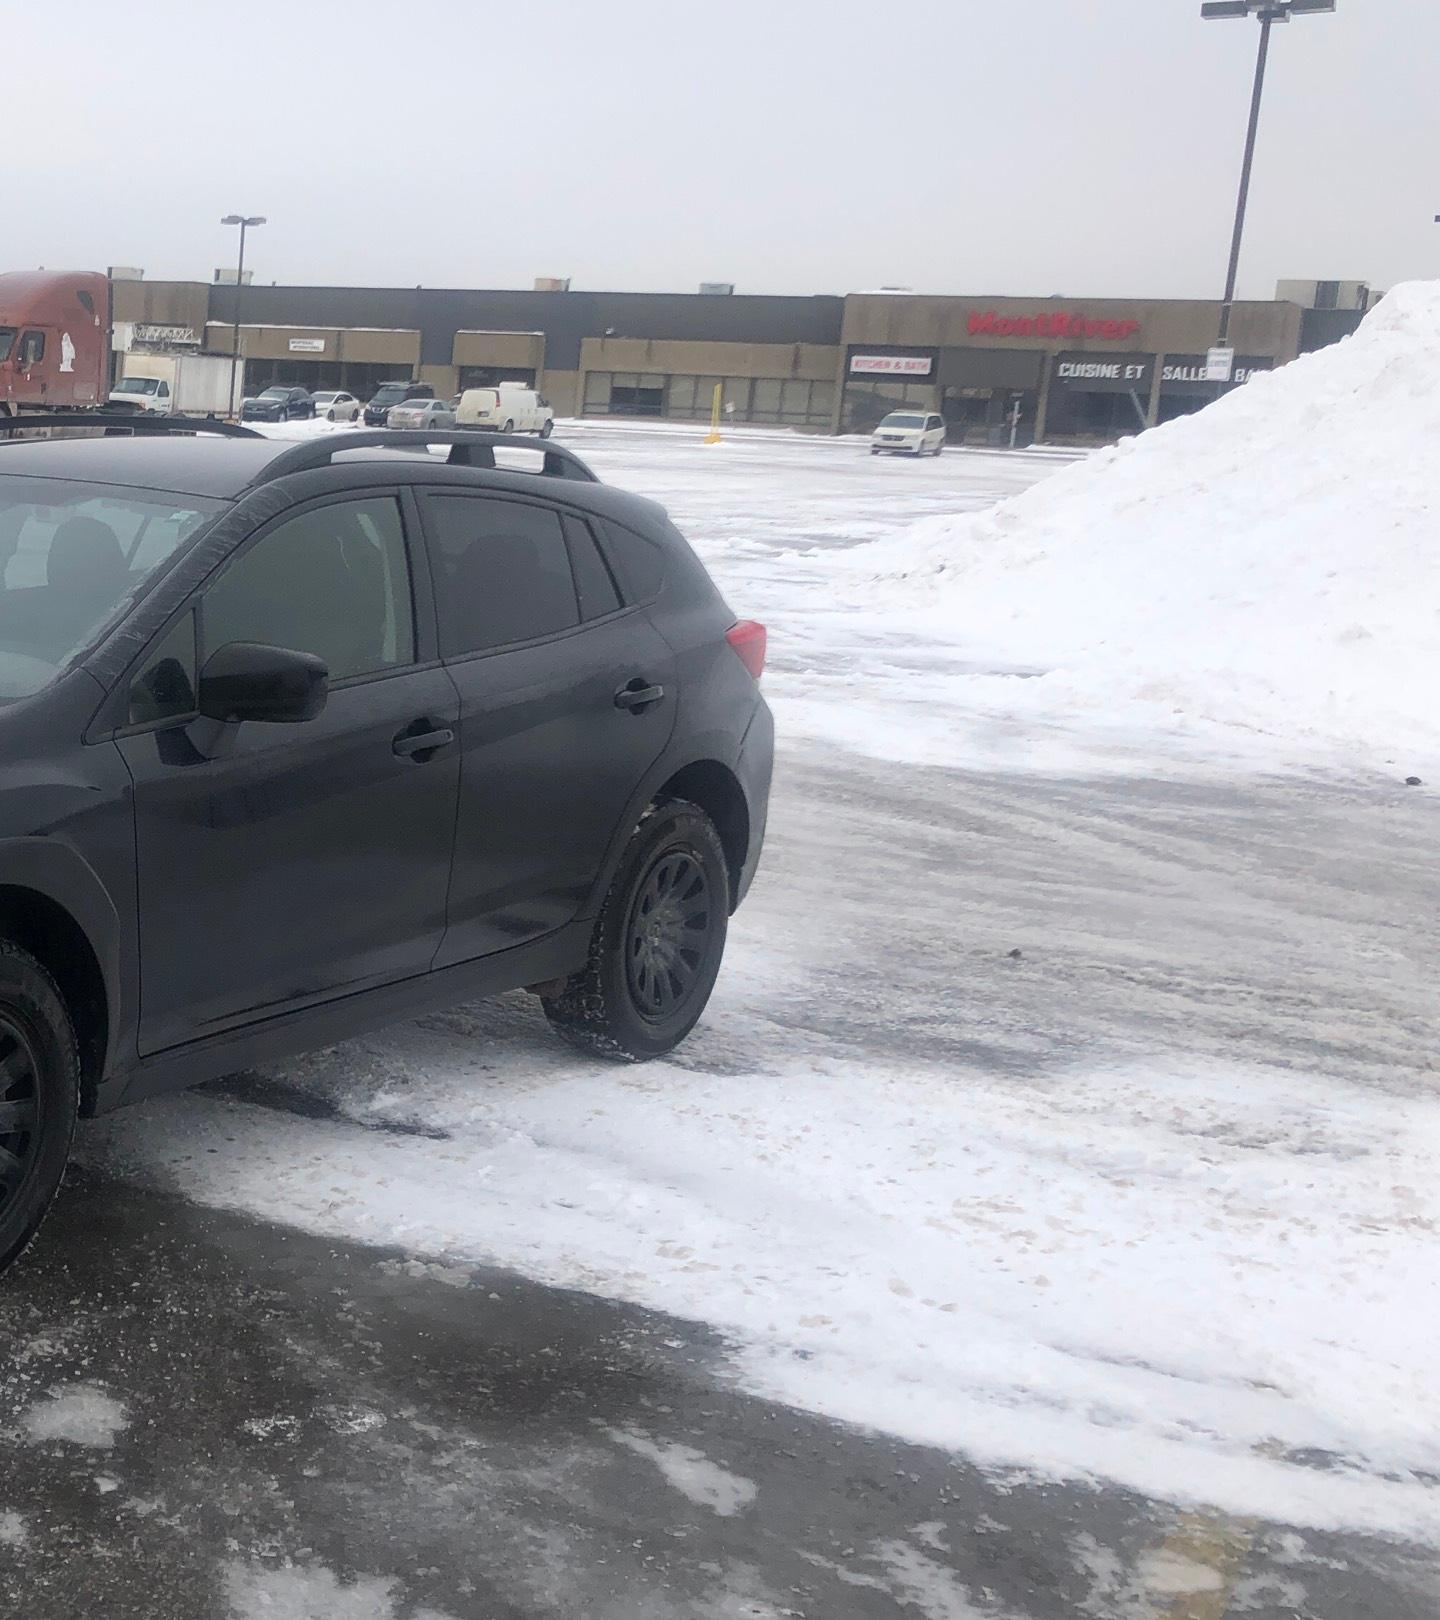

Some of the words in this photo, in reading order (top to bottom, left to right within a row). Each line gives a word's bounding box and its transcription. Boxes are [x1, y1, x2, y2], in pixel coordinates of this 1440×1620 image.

[967, 311, 1141, 339] MontRiver
[1058, 363, 1122, 379] CUISINE
[1124, 365, 1146, 379] ET
[1162, 366, 1209, 381] SALLE
